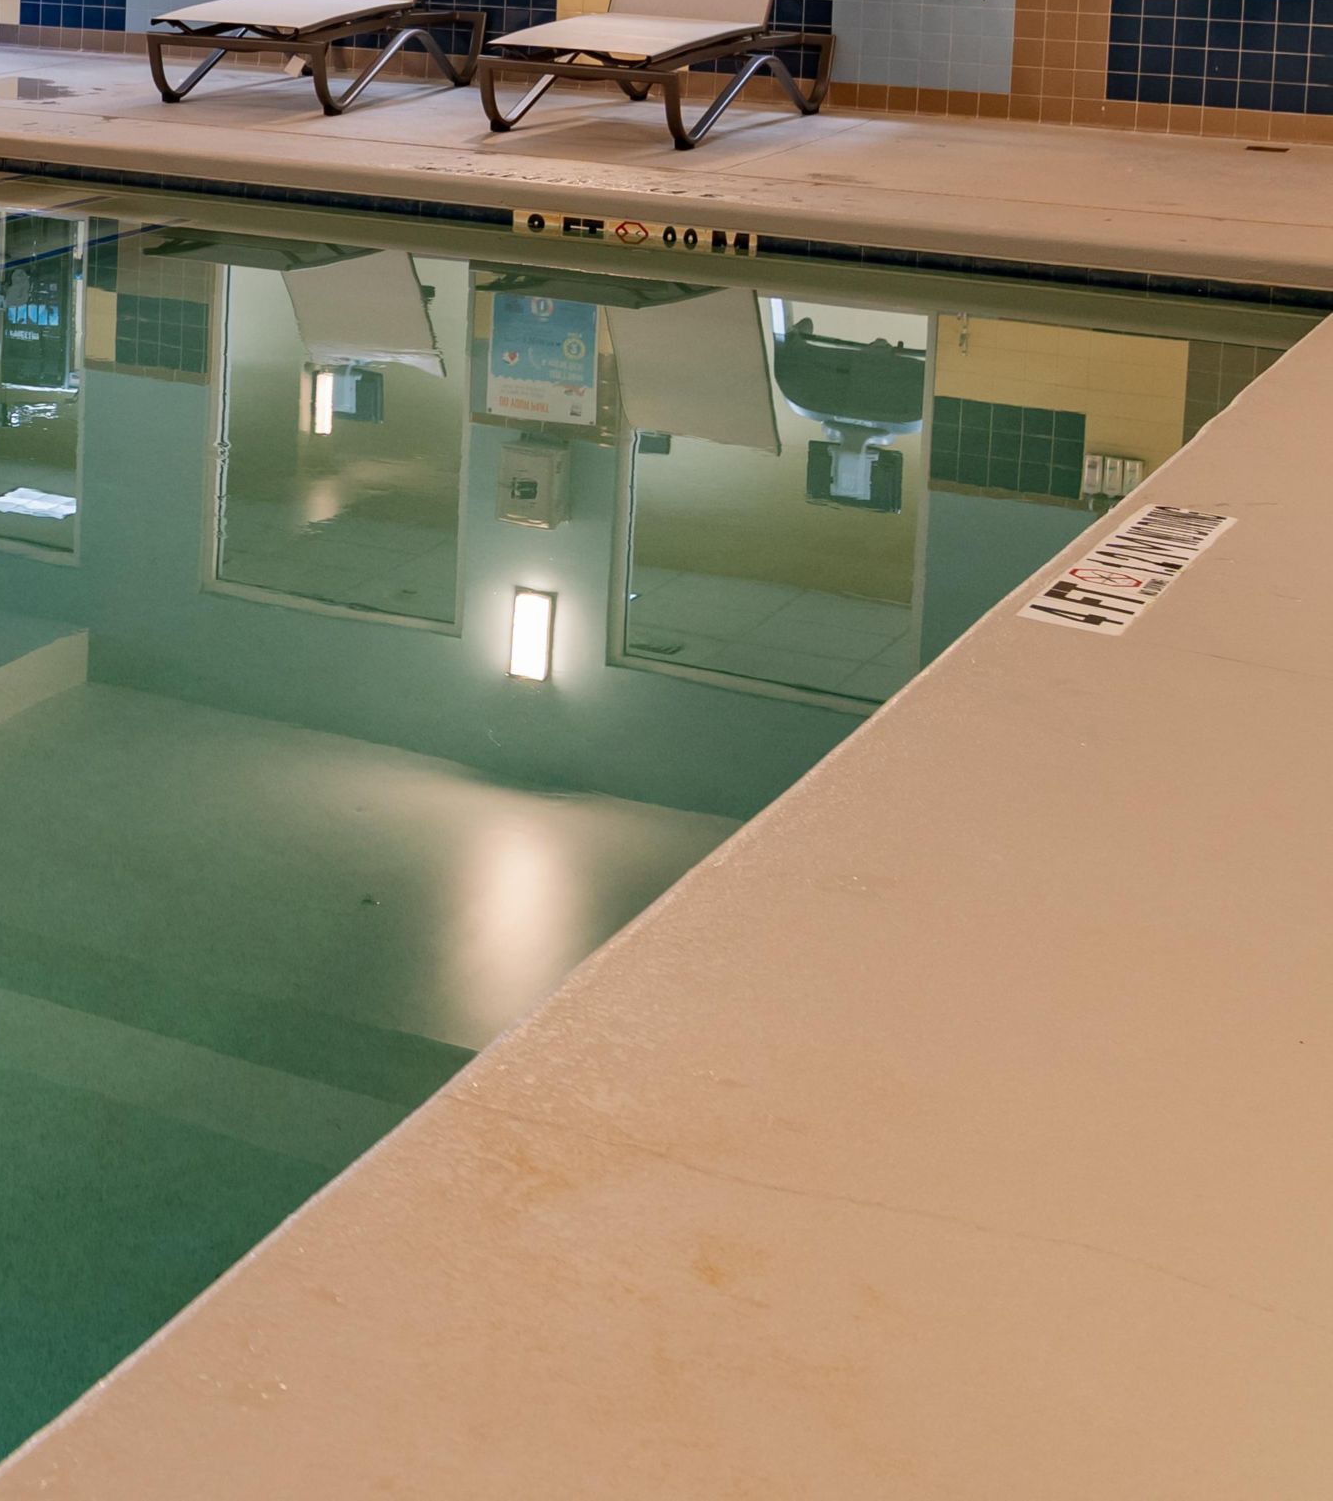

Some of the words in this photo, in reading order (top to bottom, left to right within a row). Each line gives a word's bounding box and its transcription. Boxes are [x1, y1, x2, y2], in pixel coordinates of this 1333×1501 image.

[1105, 535, 1199, 560] M
[1087, 550, 1183, 576] 1.2
[1043, 580, 1146, 615] FT
[1030, 605, 1124, 625] 4
